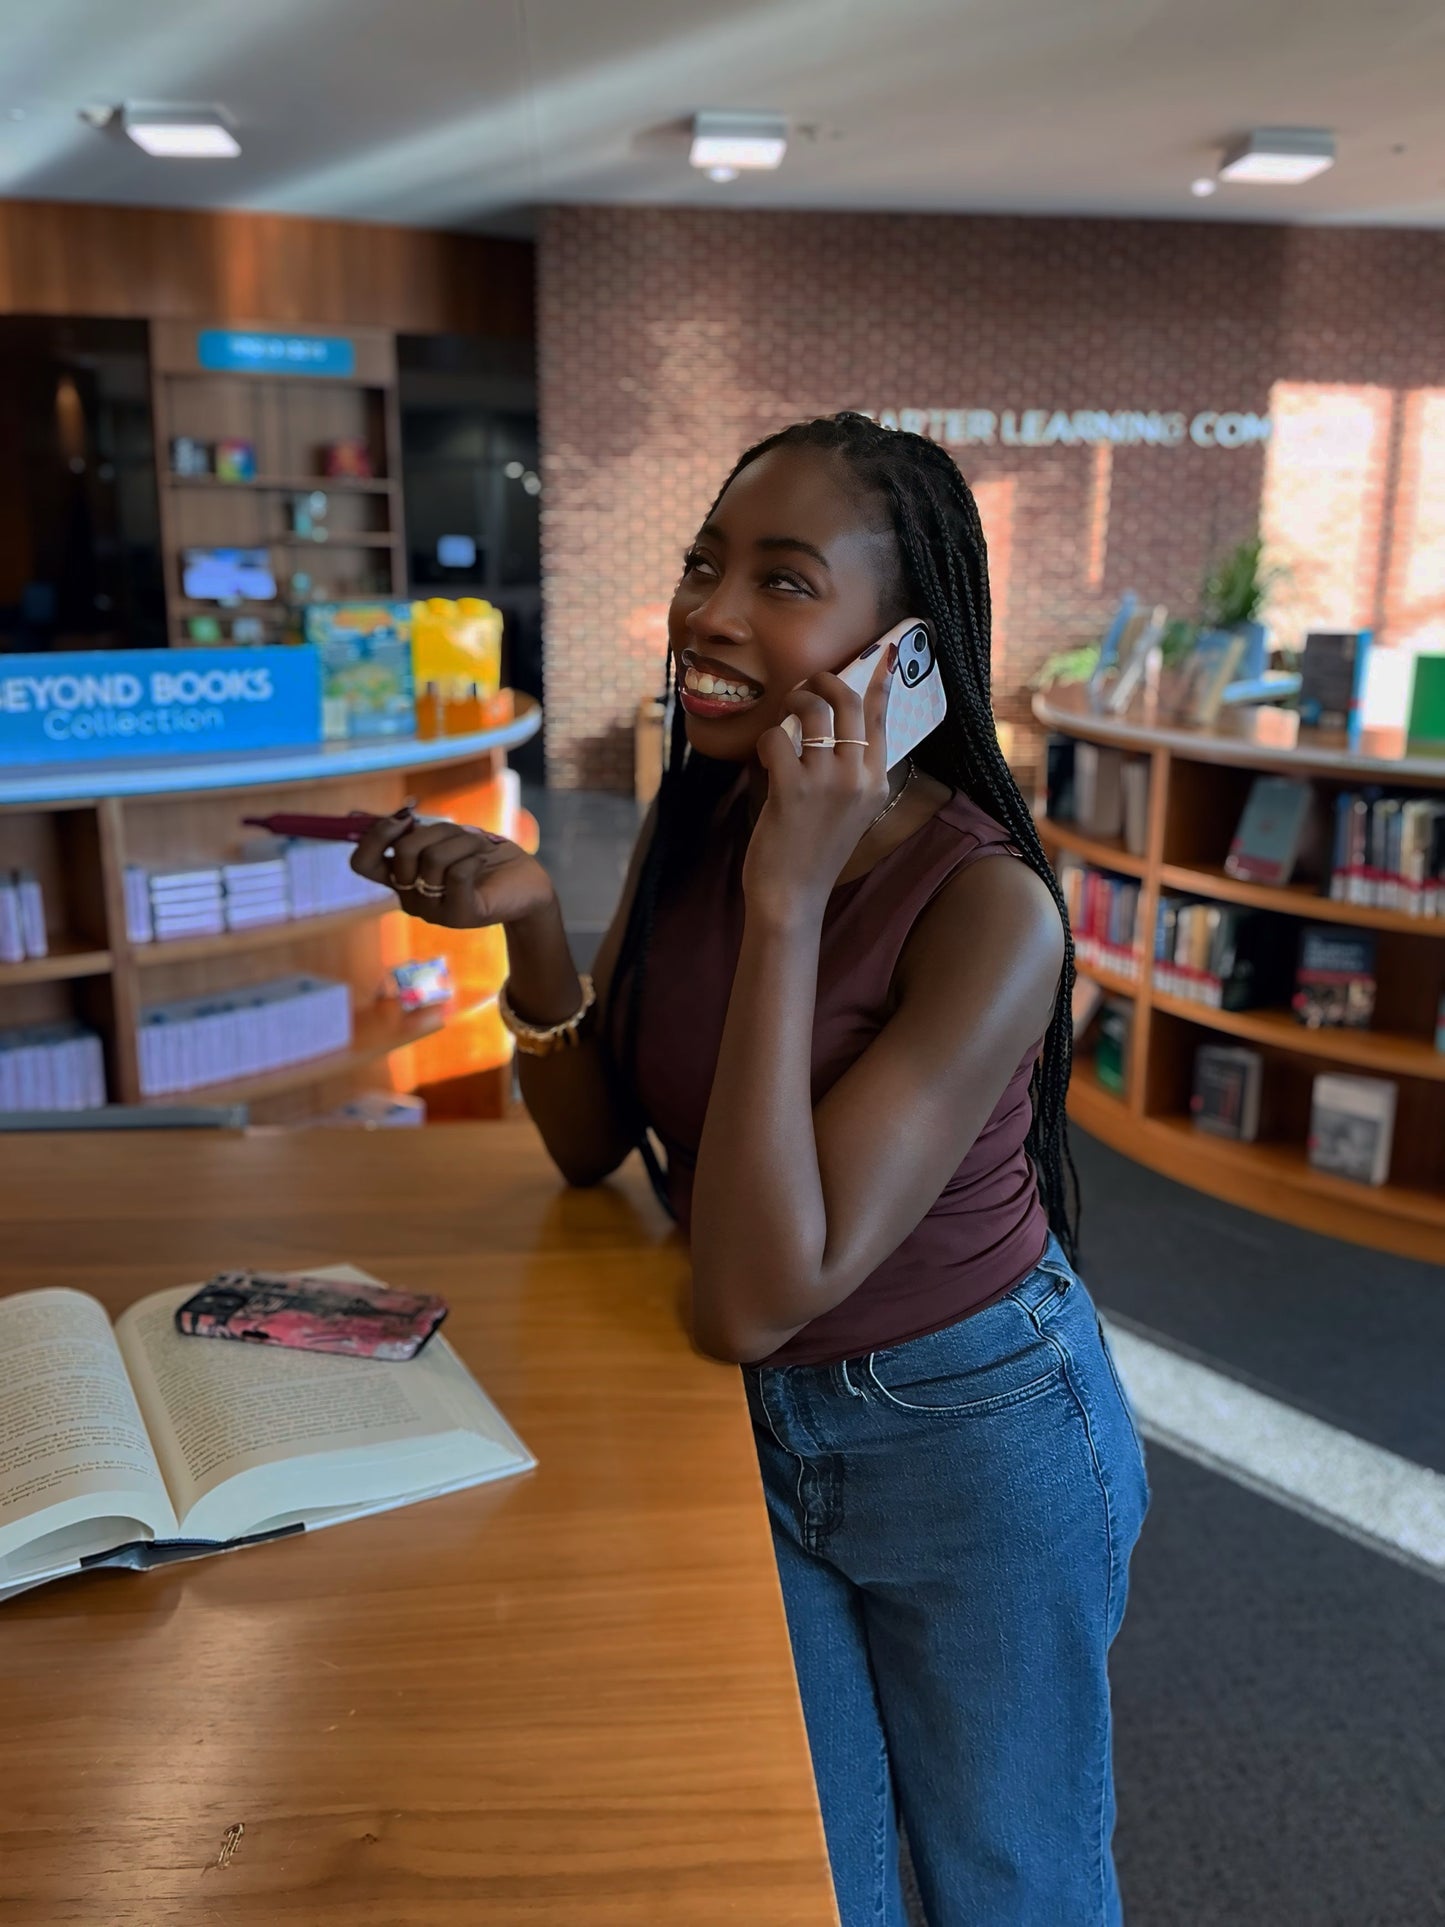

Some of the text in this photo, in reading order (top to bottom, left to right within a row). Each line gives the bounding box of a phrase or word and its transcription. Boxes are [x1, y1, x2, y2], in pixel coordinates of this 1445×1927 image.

[1001, 409, 1188, 447] LEARNING
[0, 668, 274, 712] EYOND BOOKS
[43, 706, 226, 741] Collection
